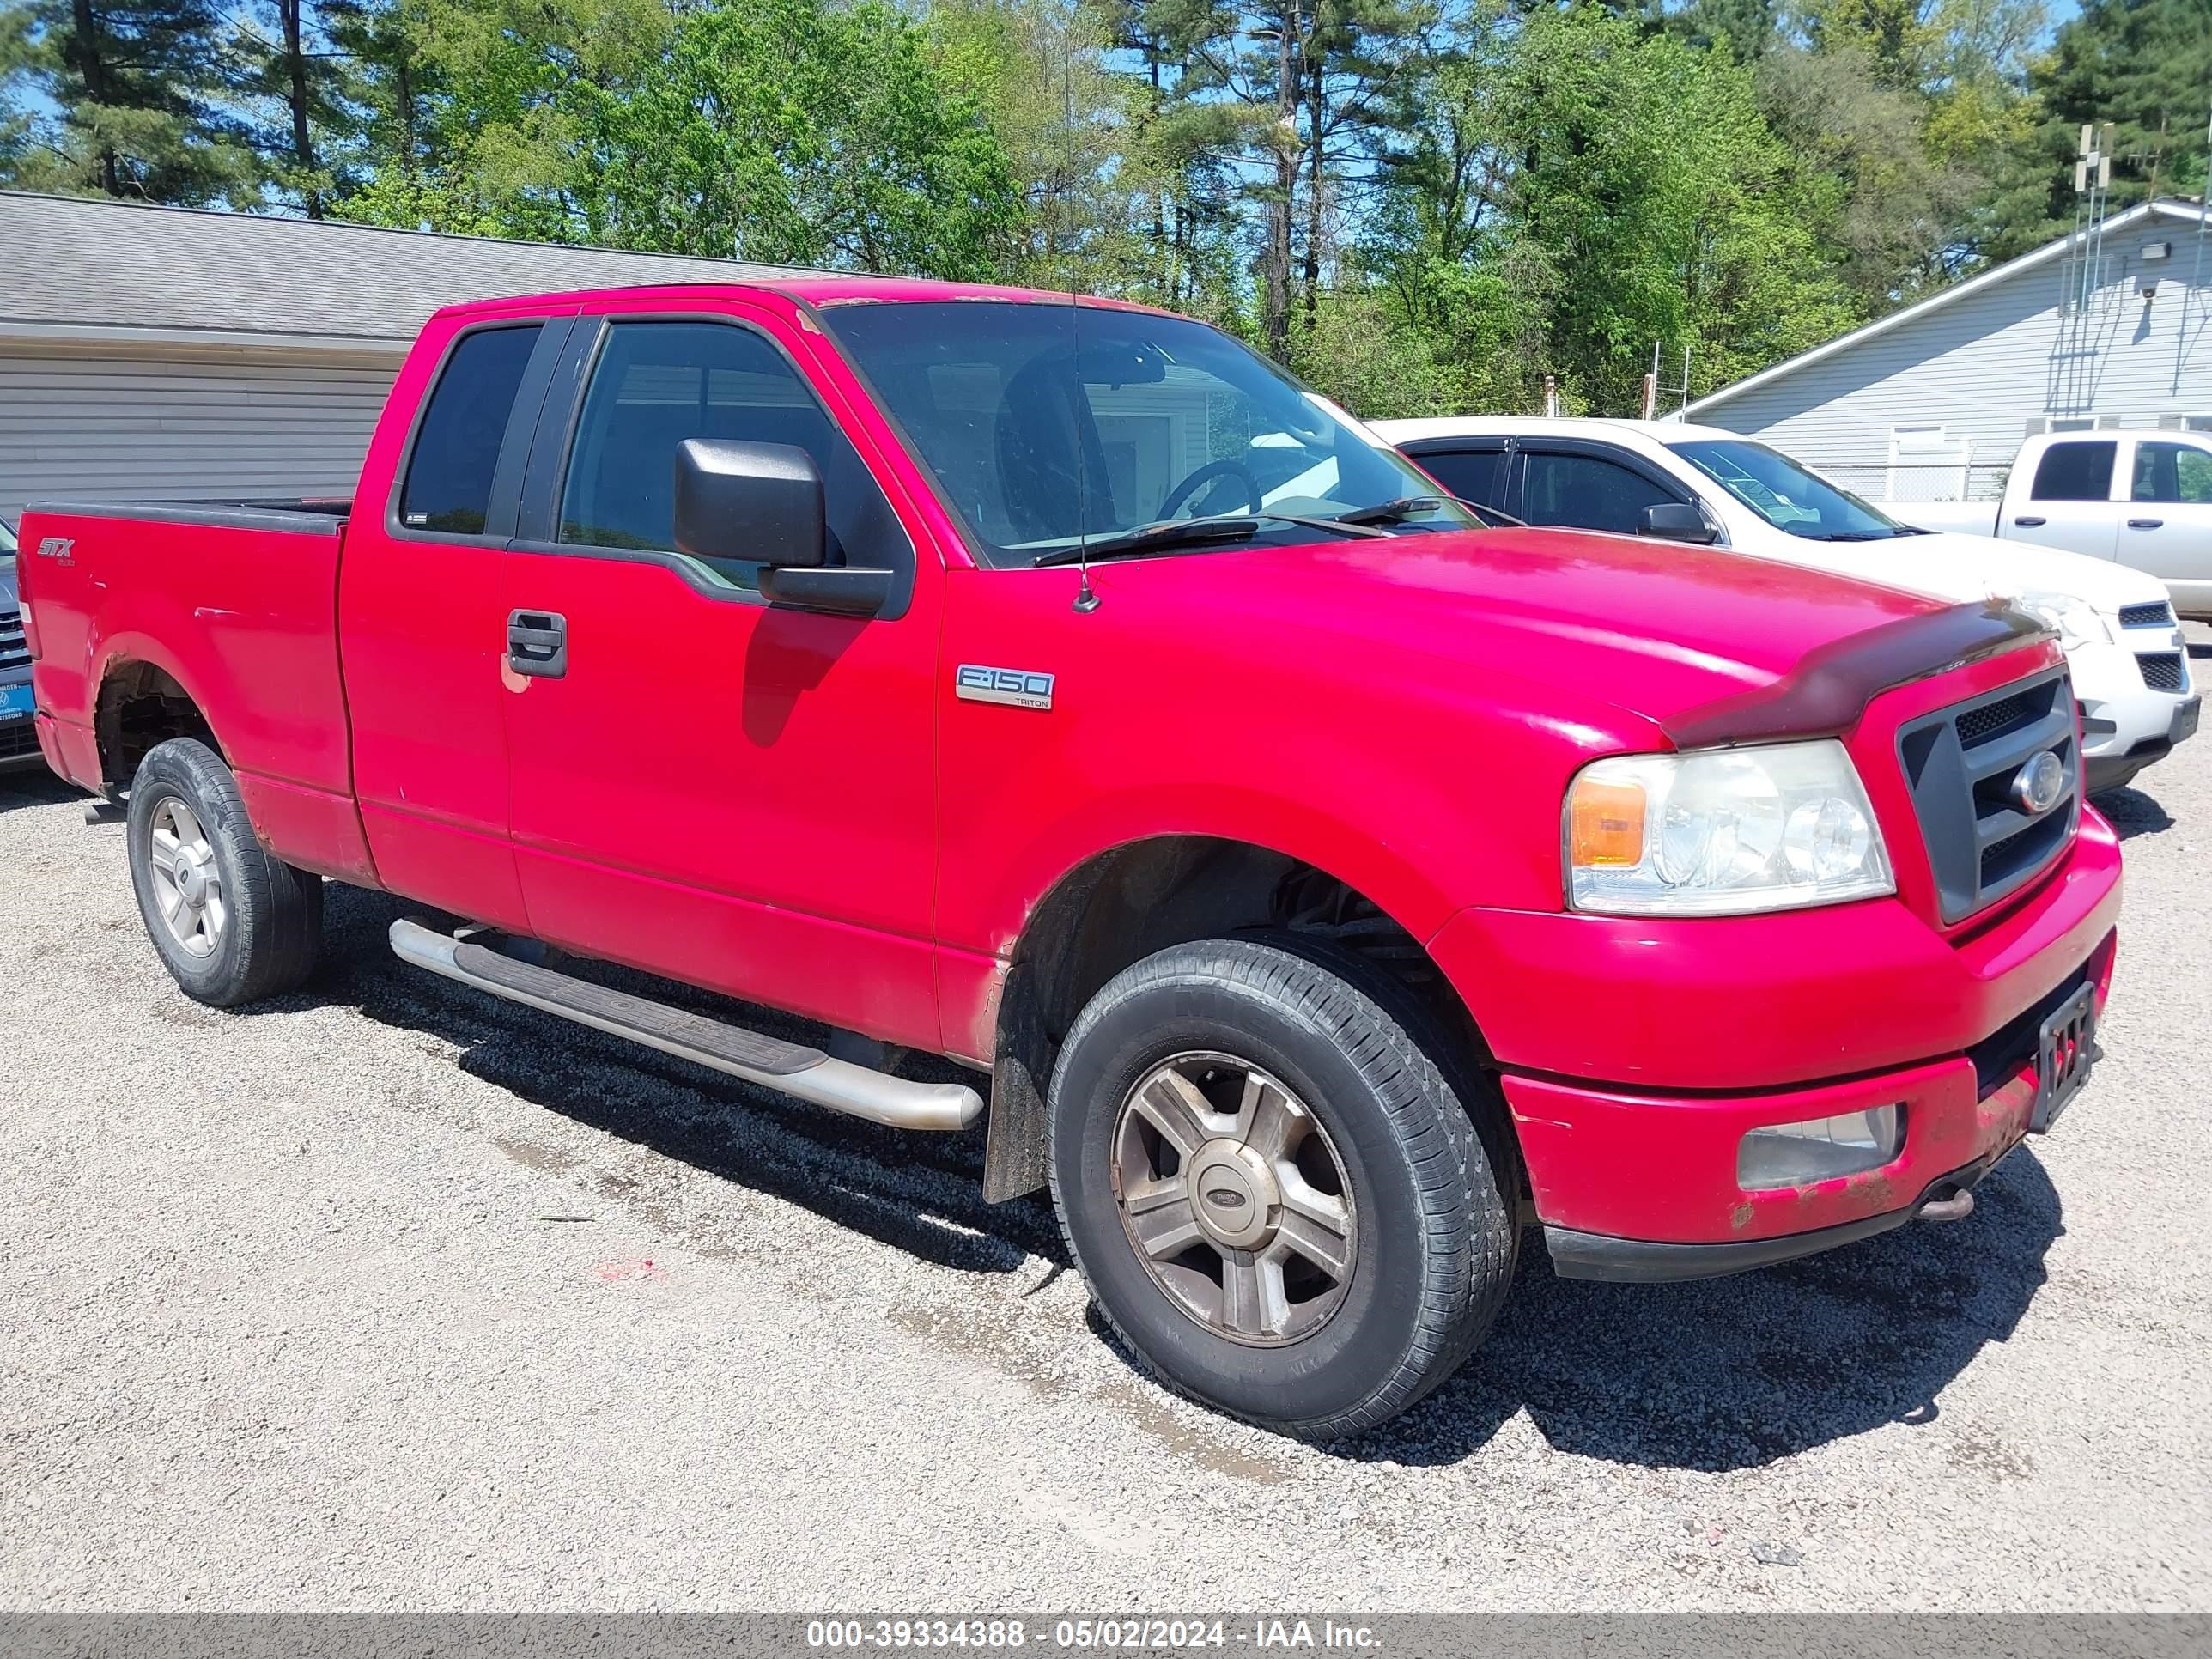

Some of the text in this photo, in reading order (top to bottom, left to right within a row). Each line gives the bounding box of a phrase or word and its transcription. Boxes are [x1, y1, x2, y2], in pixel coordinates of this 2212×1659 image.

[37, 537, 76, 557] STX
[1014, 697, 1048, 708] TRITON
[1217, 1194, 1237, 1205] Ford
